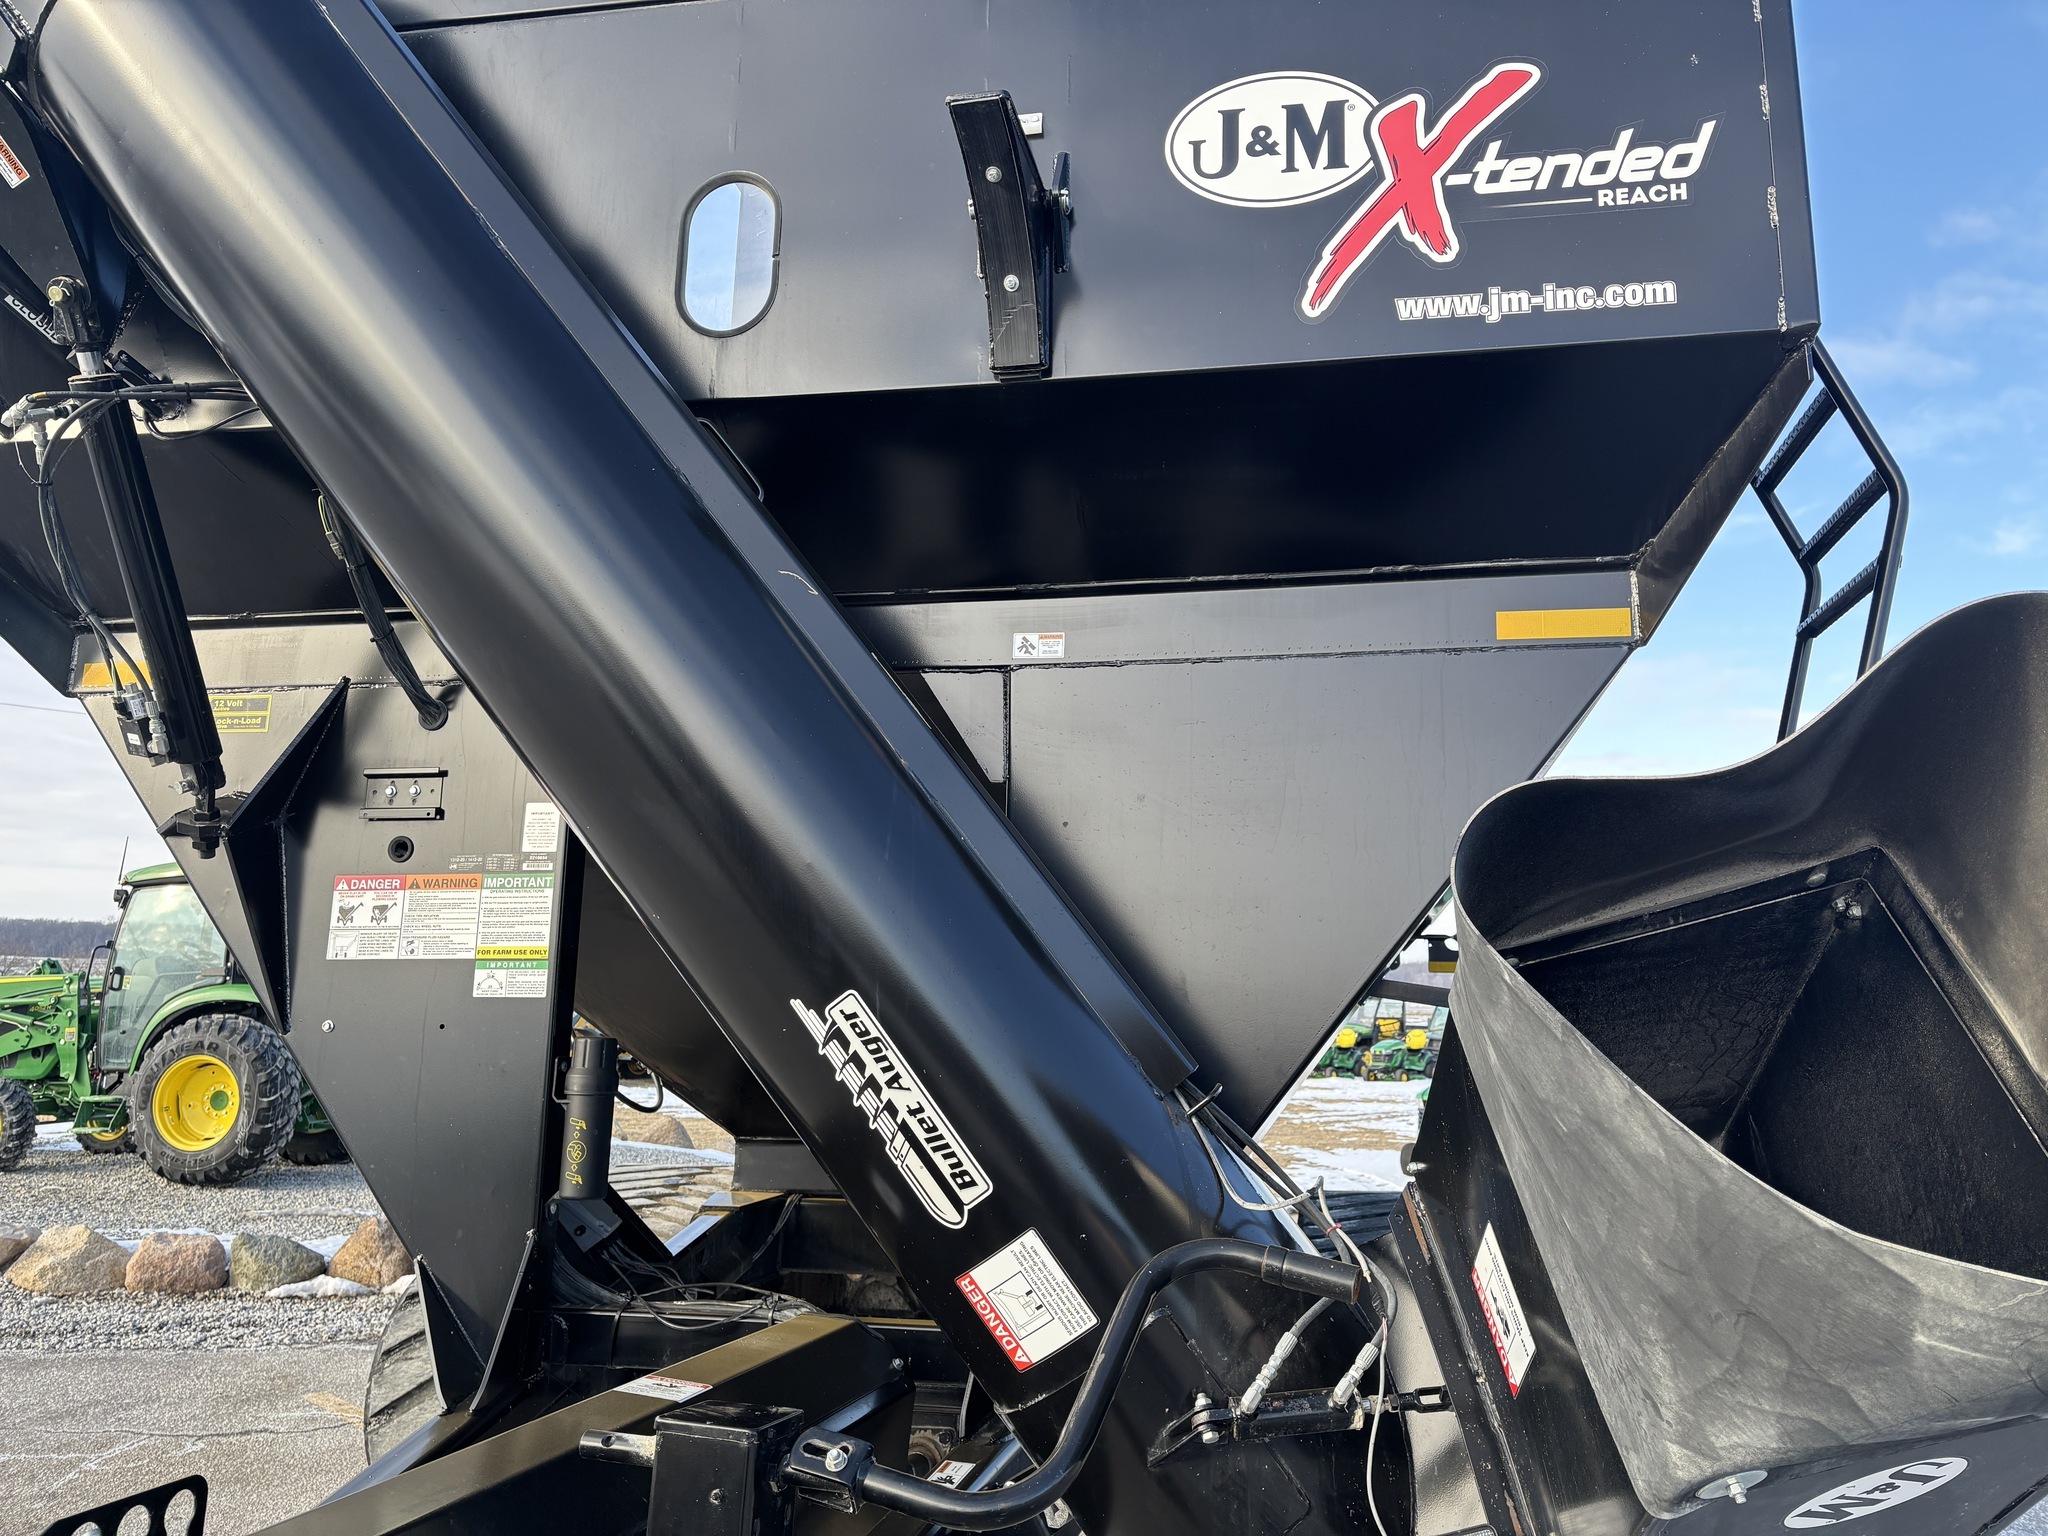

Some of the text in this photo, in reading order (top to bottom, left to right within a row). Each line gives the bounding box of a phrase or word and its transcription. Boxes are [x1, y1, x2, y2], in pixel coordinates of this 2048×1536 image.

[1597, 182, 1688, 207] REACH
[1394, 280, 1677, 322] www.jm-inc.com
[216, 716, 262, 724] ock-n-Load
[350, 879, 400, 889] DANGER
[422, 878, 478, 889] WARNING
[484, 876, 553, 888] IMPORTANT
[840, 1008, 978, 1191] Bullet Auger
[959, 1276, 1017, 1351] DANGER
[1472, 1267, 1511, 1369] DANGER
[1790, 1461, 1954, 1522] J&M
